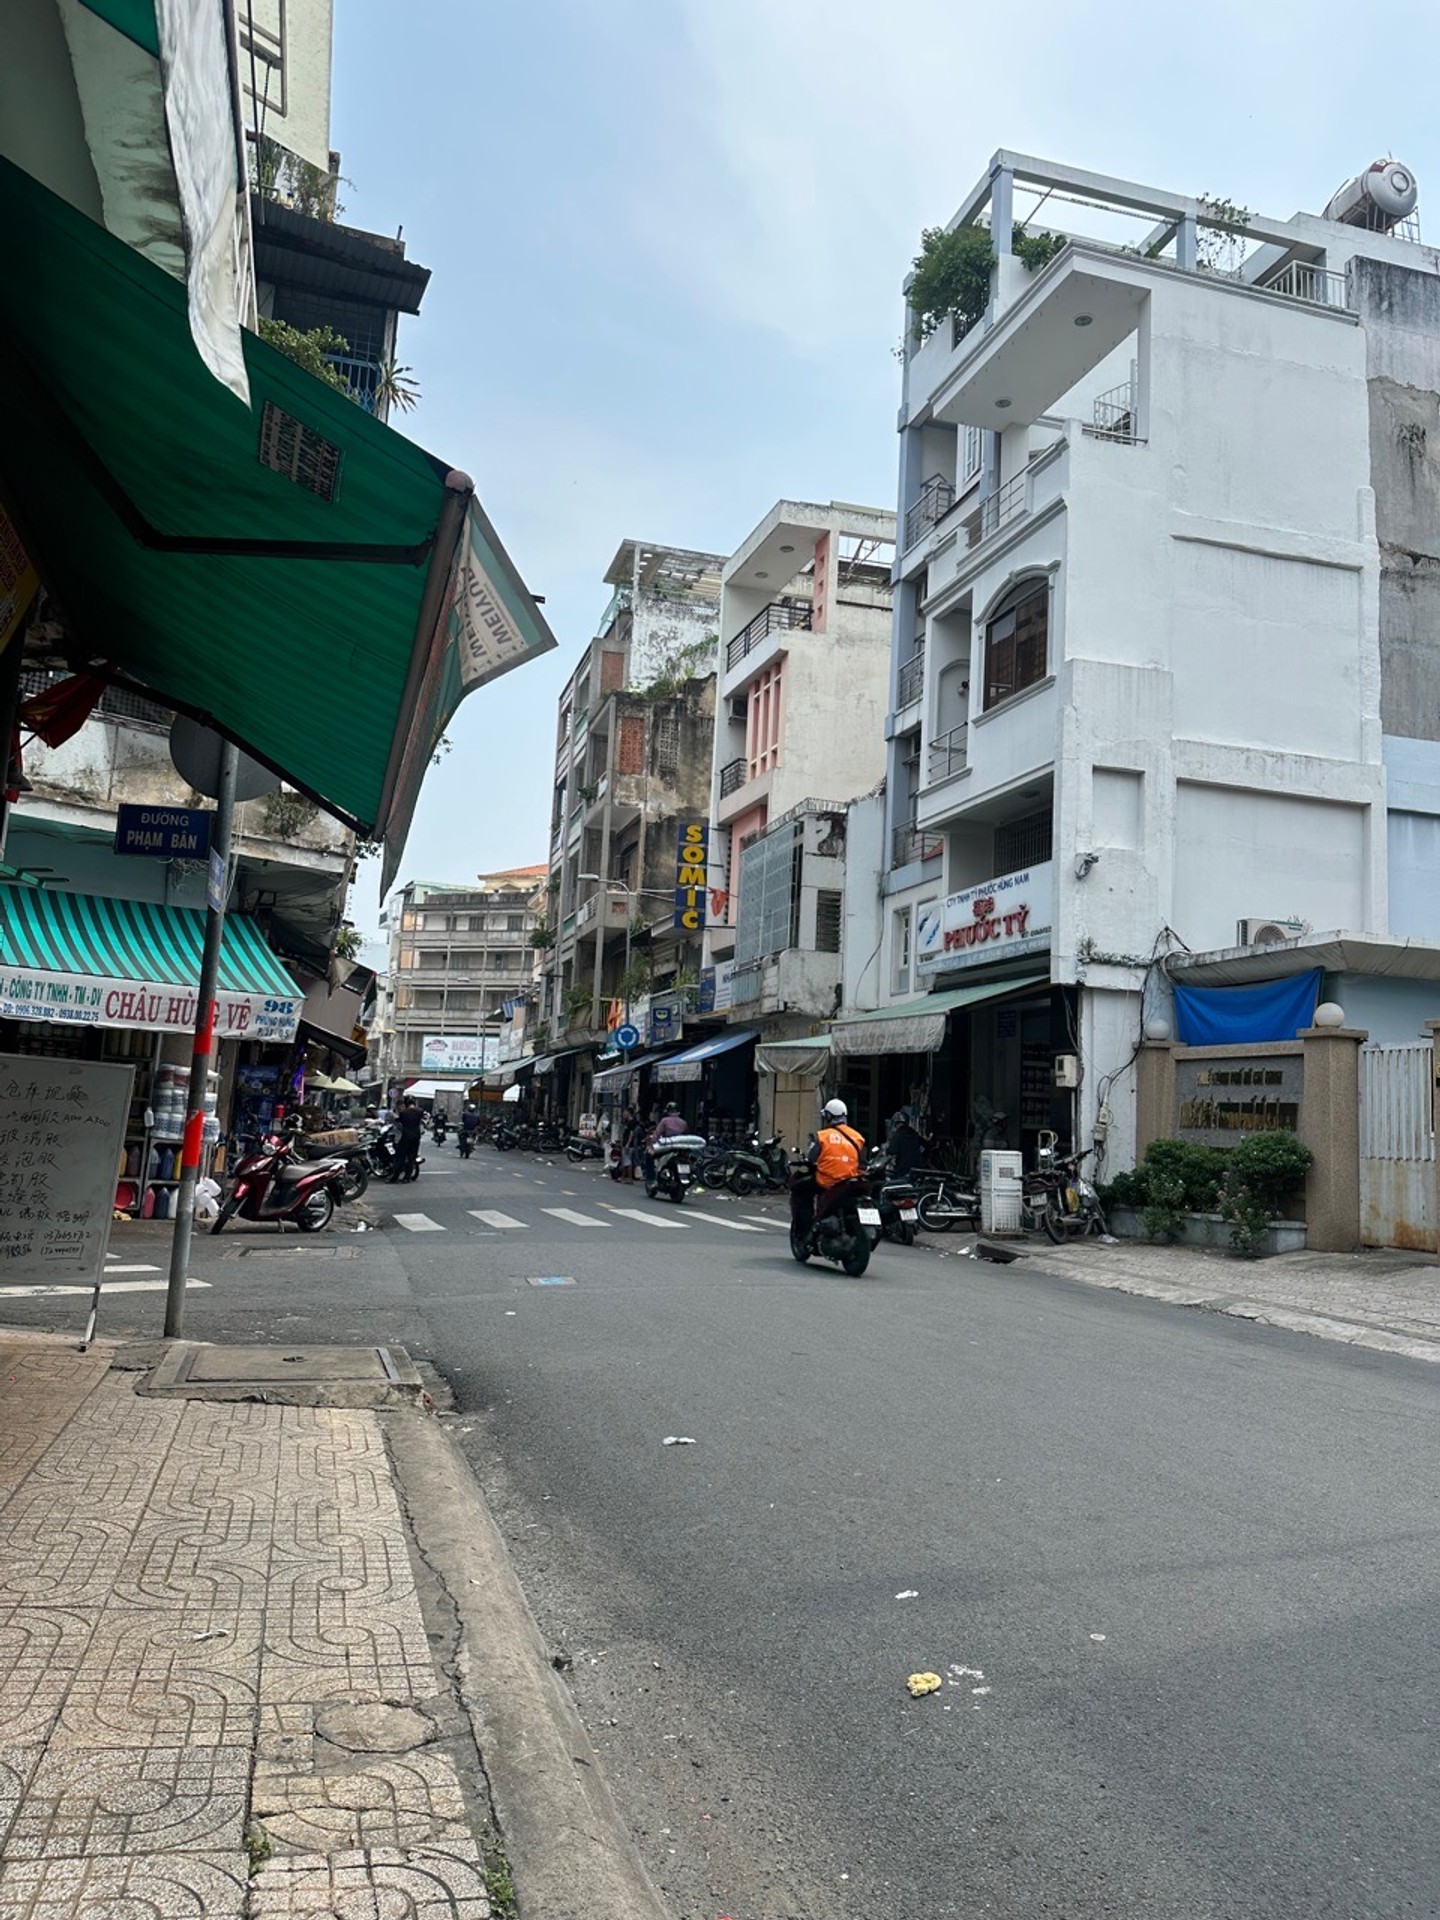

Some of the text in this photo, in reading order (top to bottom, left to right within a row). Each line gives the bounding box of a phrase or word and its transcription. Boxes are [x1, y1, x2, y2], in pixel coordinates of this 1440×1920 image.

[141, 812, 189, 826] ĐƯỜNG
[126, 830, 198, 850] PHẠM BÂN
[678, 823, 706, 929] SOMIC
[1014, 872, 1030, 886] NAM
[943, 915, 1001, 952] PHƯỚC
[35, 981, 46, 1000] TY
[74, 985, 87, 1004] TM
[105, 986, 162, 1022] CHÂU
[165, 990, 221, 1027] HÙG
[264, 999, 294, 1015] 98
